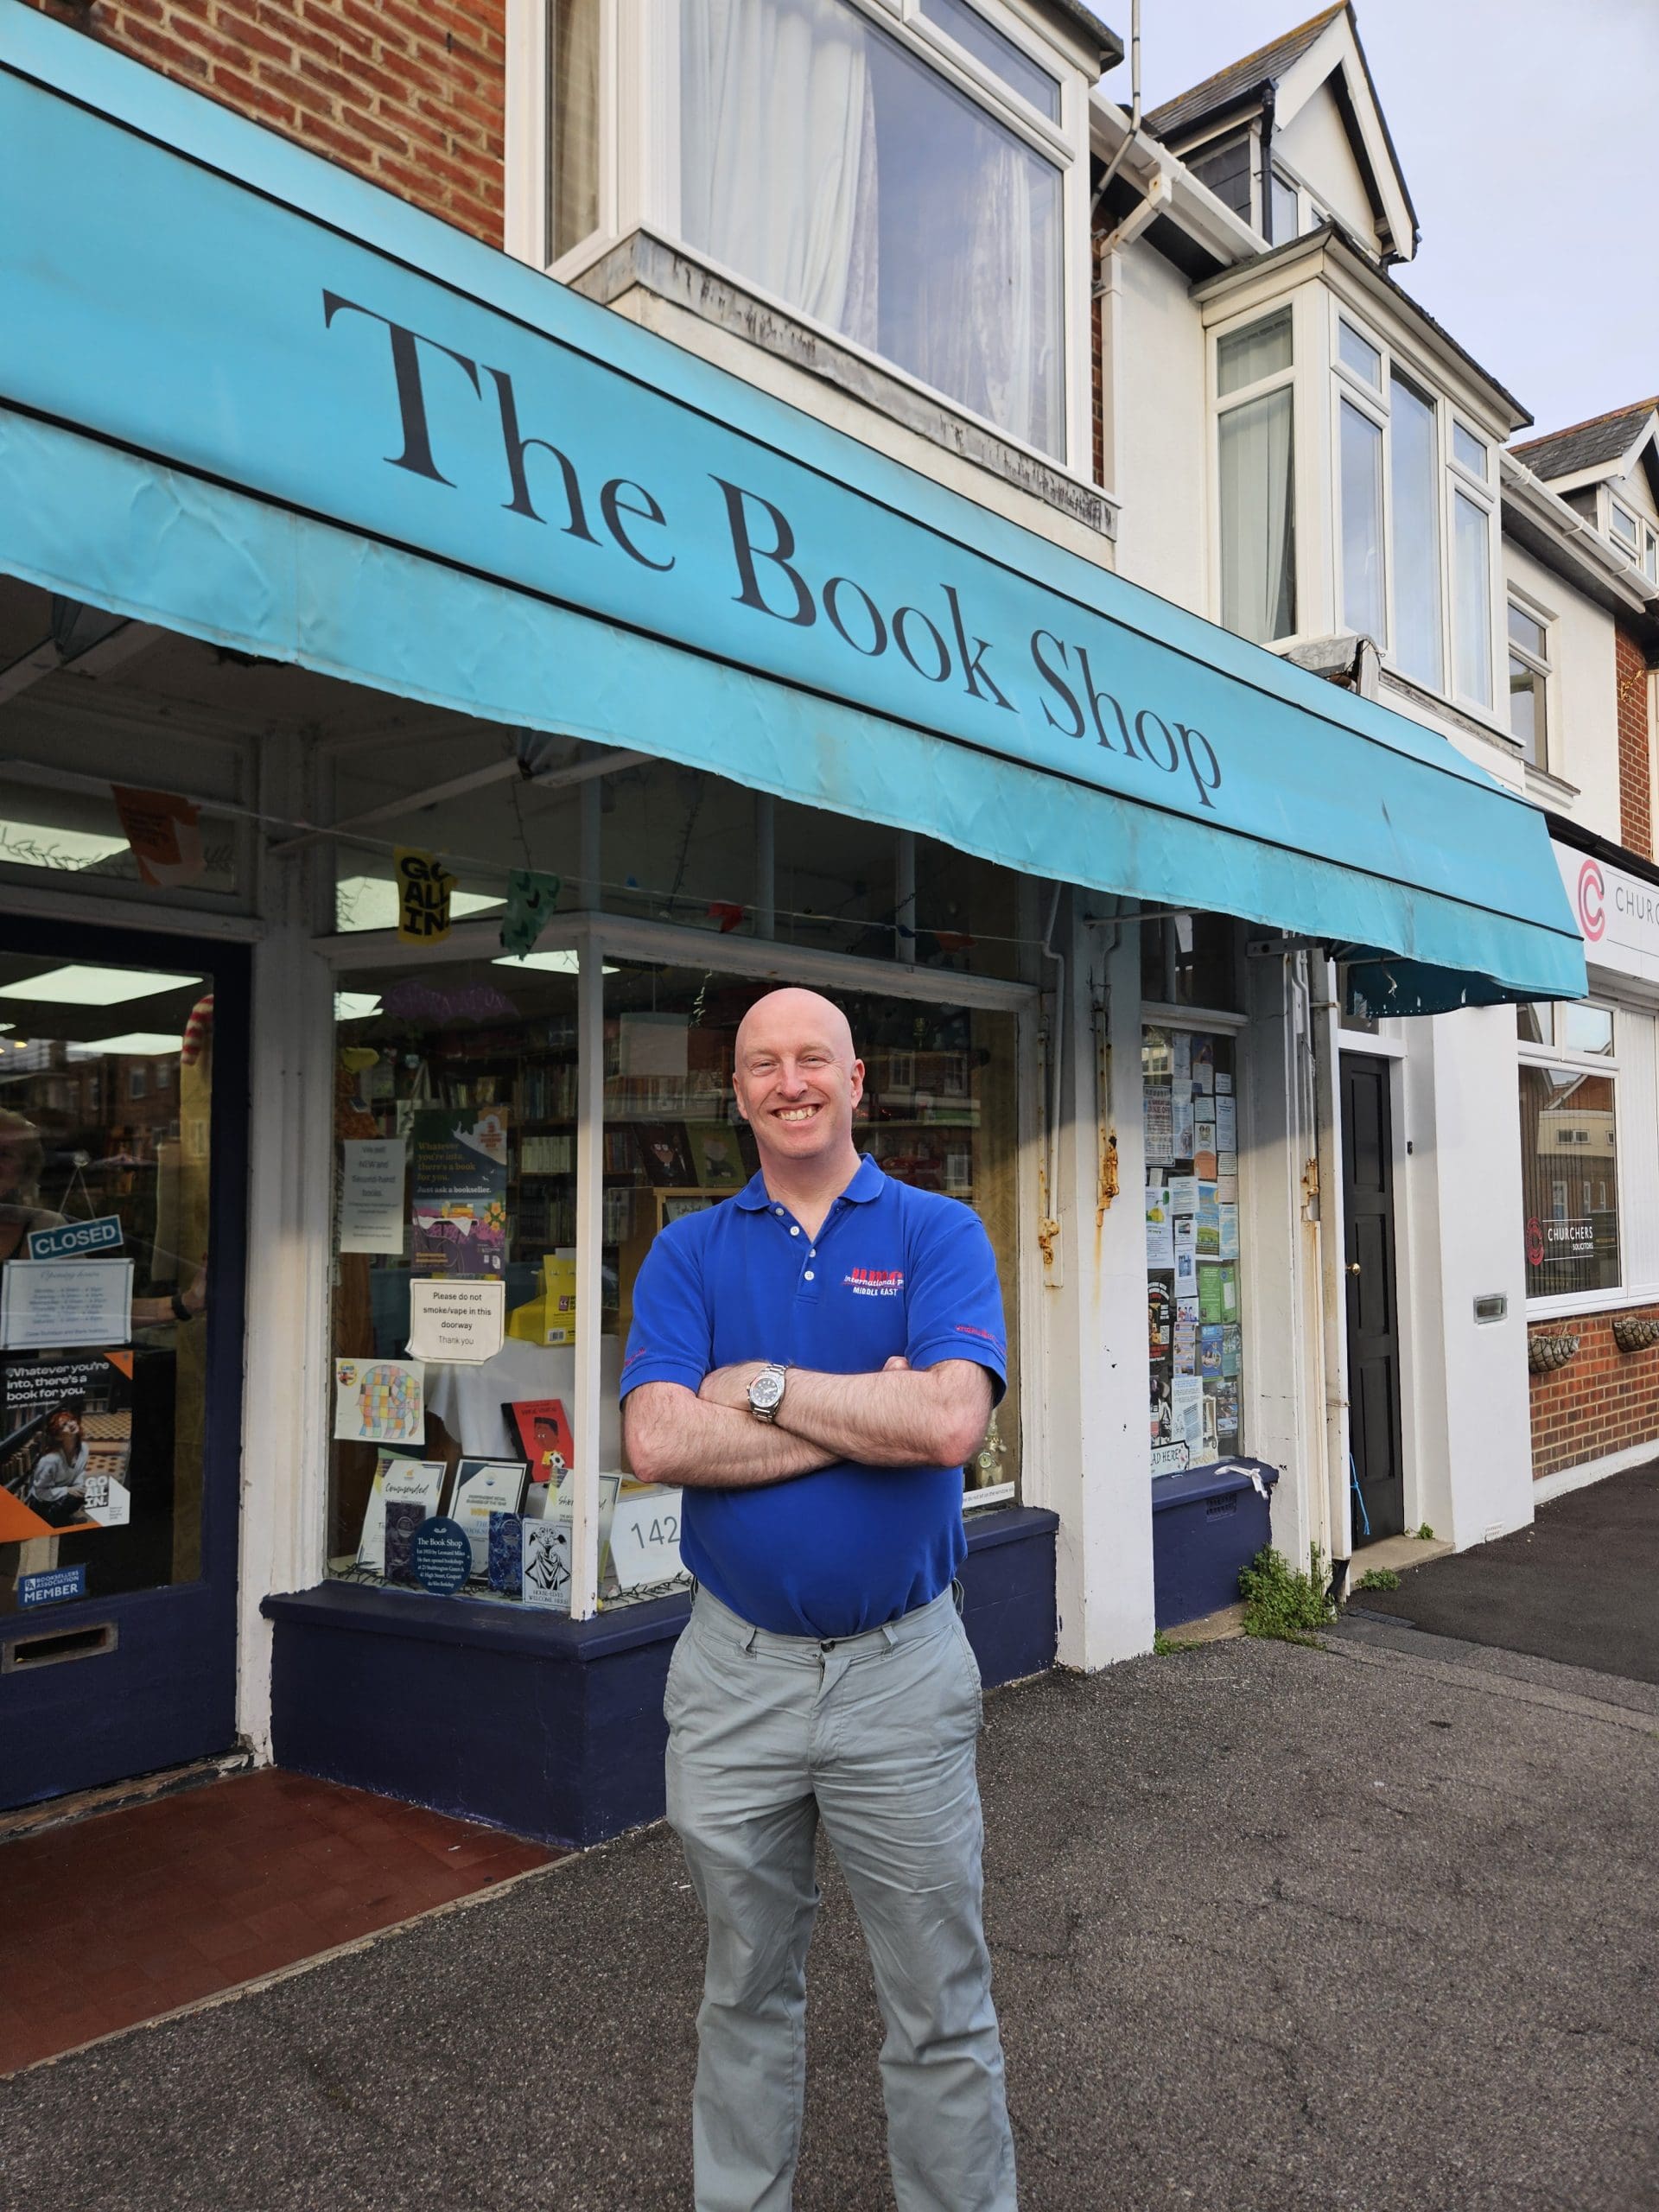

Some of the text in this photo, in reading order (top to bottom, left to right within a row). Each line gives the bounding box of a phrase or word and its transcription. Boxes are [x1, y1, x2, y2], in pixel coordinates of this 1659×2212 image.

[323, 289, 1222, 809] The Book Shop
[454, 1161, 476, 1171] book
[454, 1185, 492, 1193] bookseller.
[35, 1224, 116, 1254] CLOSED
[1548, 1226, 1593, 1242] CHURCHERS
[853, 1287, 899, 1296] MIDDLE EAST
[423, 1306, 467, 1316] smoke/vape
[441, 1320, 473, 1331] doorway
[439, 1335, 474, 1346] Thank you
[71, 1362, 110, 1374] you're
[7, 1380, 34, 1389] into,
[35, 1374, 79, 1387] there's
[7, 1387, 86, 1401] book for you.
[86, 1476, 108, 1486] GO
[85, 1486, 107, 1498] ALL
[385, 1483, 429, 1496] Commended
[85, 1497, 107, 1508] IN.
[630, 1516, 681, 1549] 142
[447, 1538, 463, 1548] Shop
[36, 1570, 79, 1583] BOOKSELLERS
[36, 1576, 79, 1588] ASSOCIATION
[24, 1583, 79, 1603] MEMBER
